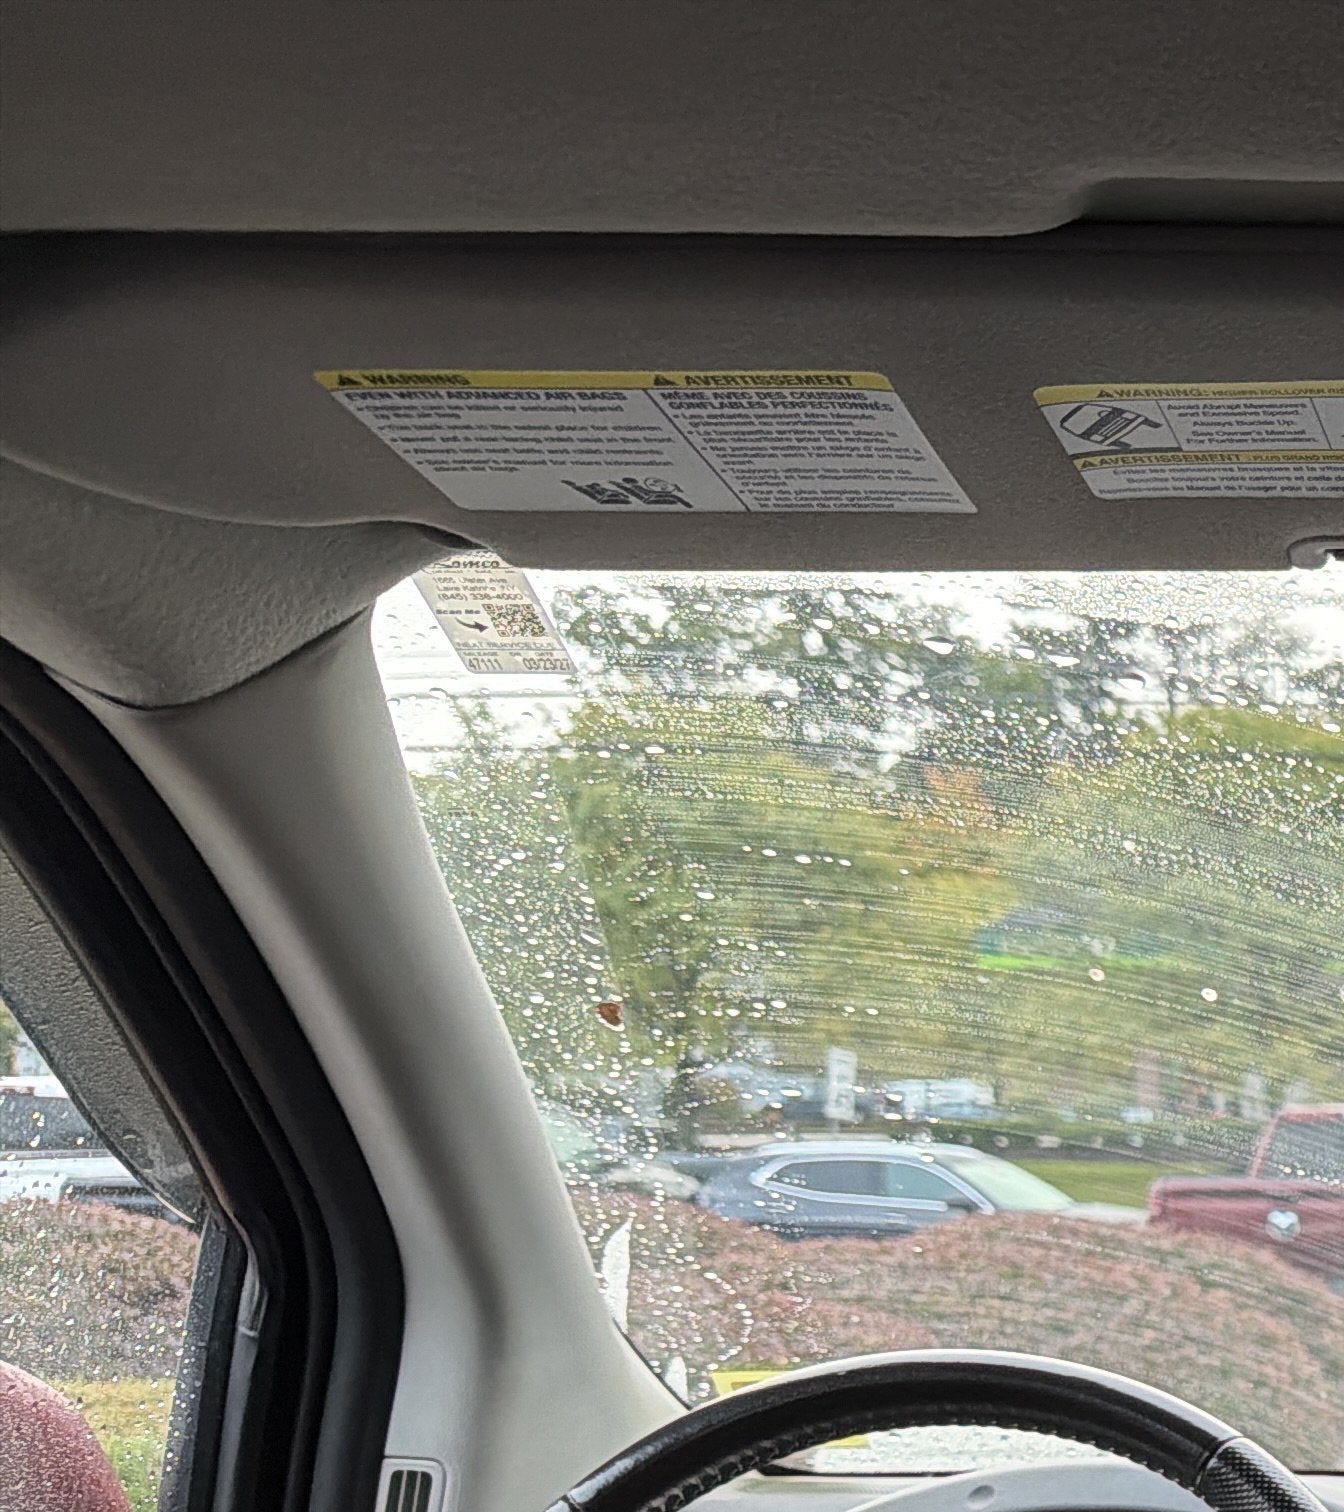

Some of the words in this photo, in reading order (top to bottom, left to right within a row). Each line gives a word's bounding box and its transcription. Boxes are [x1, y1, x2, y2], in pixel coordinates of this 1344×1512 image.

[361, 374, 471, 385] WARNING
[685, 375, 852, 386] AVERTISSEMENT
[345, 392, 392, 400] EVEN
[394, 391, 442, 399] WITH
[446, 391, 540, 400] ADVANCED
[1099, 453, 1241, 466] AVERTISSEMENT
[438, 593, 467, 602] (845)
